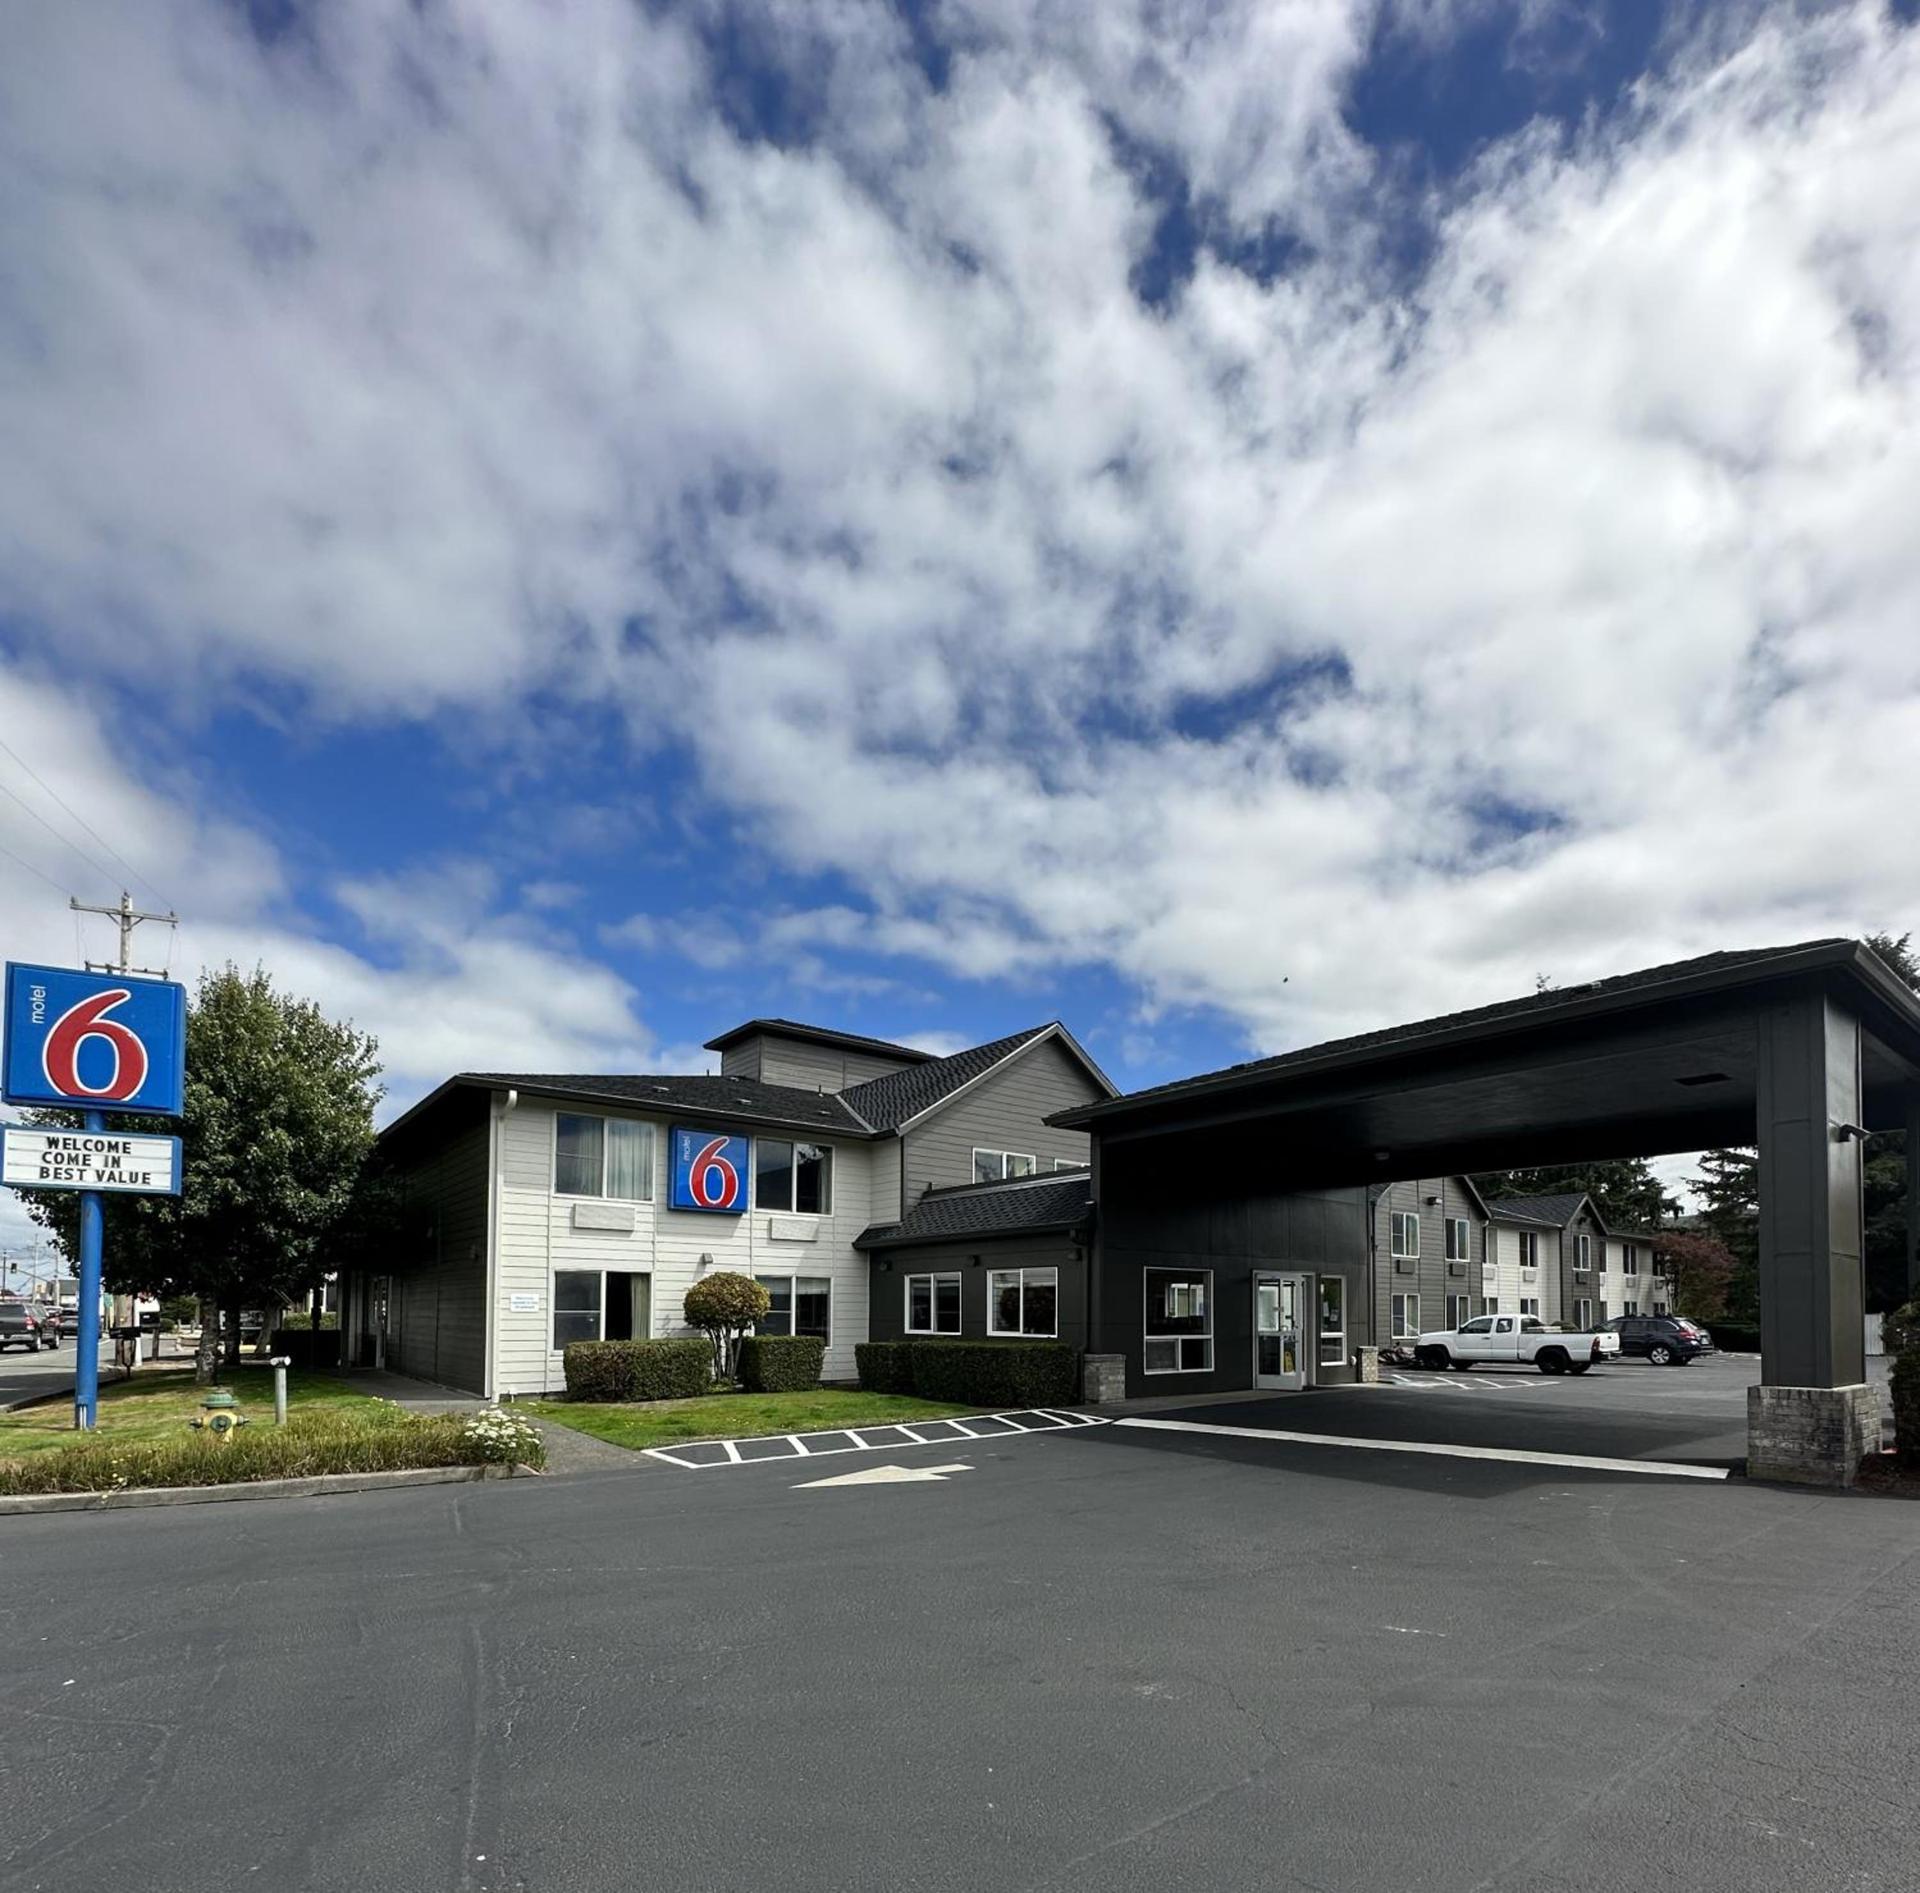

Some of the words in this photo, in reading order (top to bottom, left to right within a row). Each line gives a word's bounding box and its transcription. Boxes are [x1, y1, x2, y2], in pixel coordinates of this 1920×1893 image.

[30, 985, 46, 1024] motel
[42, 989, 148, 1101] 6
[42, 1151, 92, 1167] COME
[103, 1155, 121, 1168] IN
[46, 1136, 131, 1154] WELCOME
[39, 1166, 87, 1181] BEST
[95, 1169, 151, 1185] VALUE
[689, 1136, 738, 1208] 6
